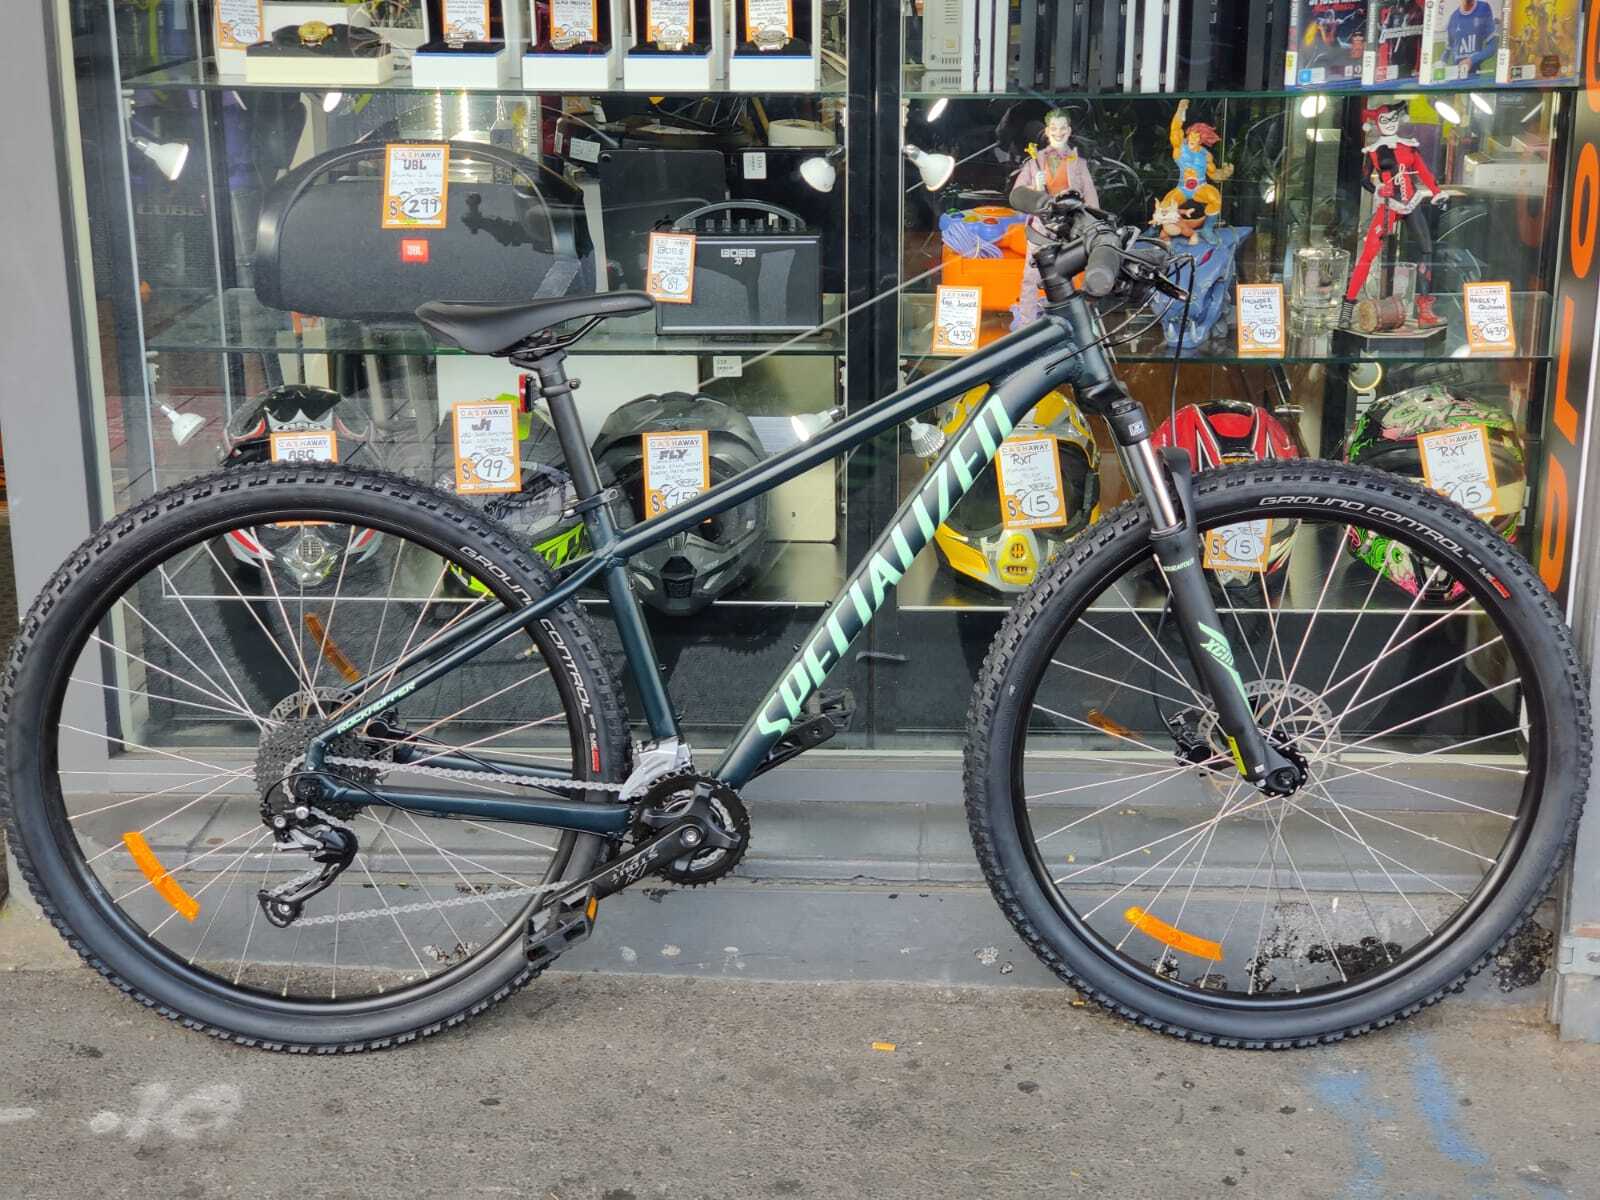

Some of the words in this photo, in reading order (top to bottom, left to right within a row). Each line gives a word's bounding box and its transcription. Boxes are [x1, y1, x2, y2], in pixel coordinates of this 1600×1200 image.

[720, 248, 756, 258] BOSS
[659, 449, 688, 460] FLY
[1010, 452, 1034, 466] RXT
[1440, 445, 1466, 458] RXT
[1029, 494, 1051, 513] 15
[1459, 485, 1483, 505] 15
[1258, 495, 1365, 514] GROUND
[1366, 505, 1464, 560] CONTROL
[1233, 538, 1252, 555] 15
[459, 545, 535, 607] GROUN
[539, 617, 593, 714] CONTROL
[336, 680, 417, 735] ROCKHOPPER
